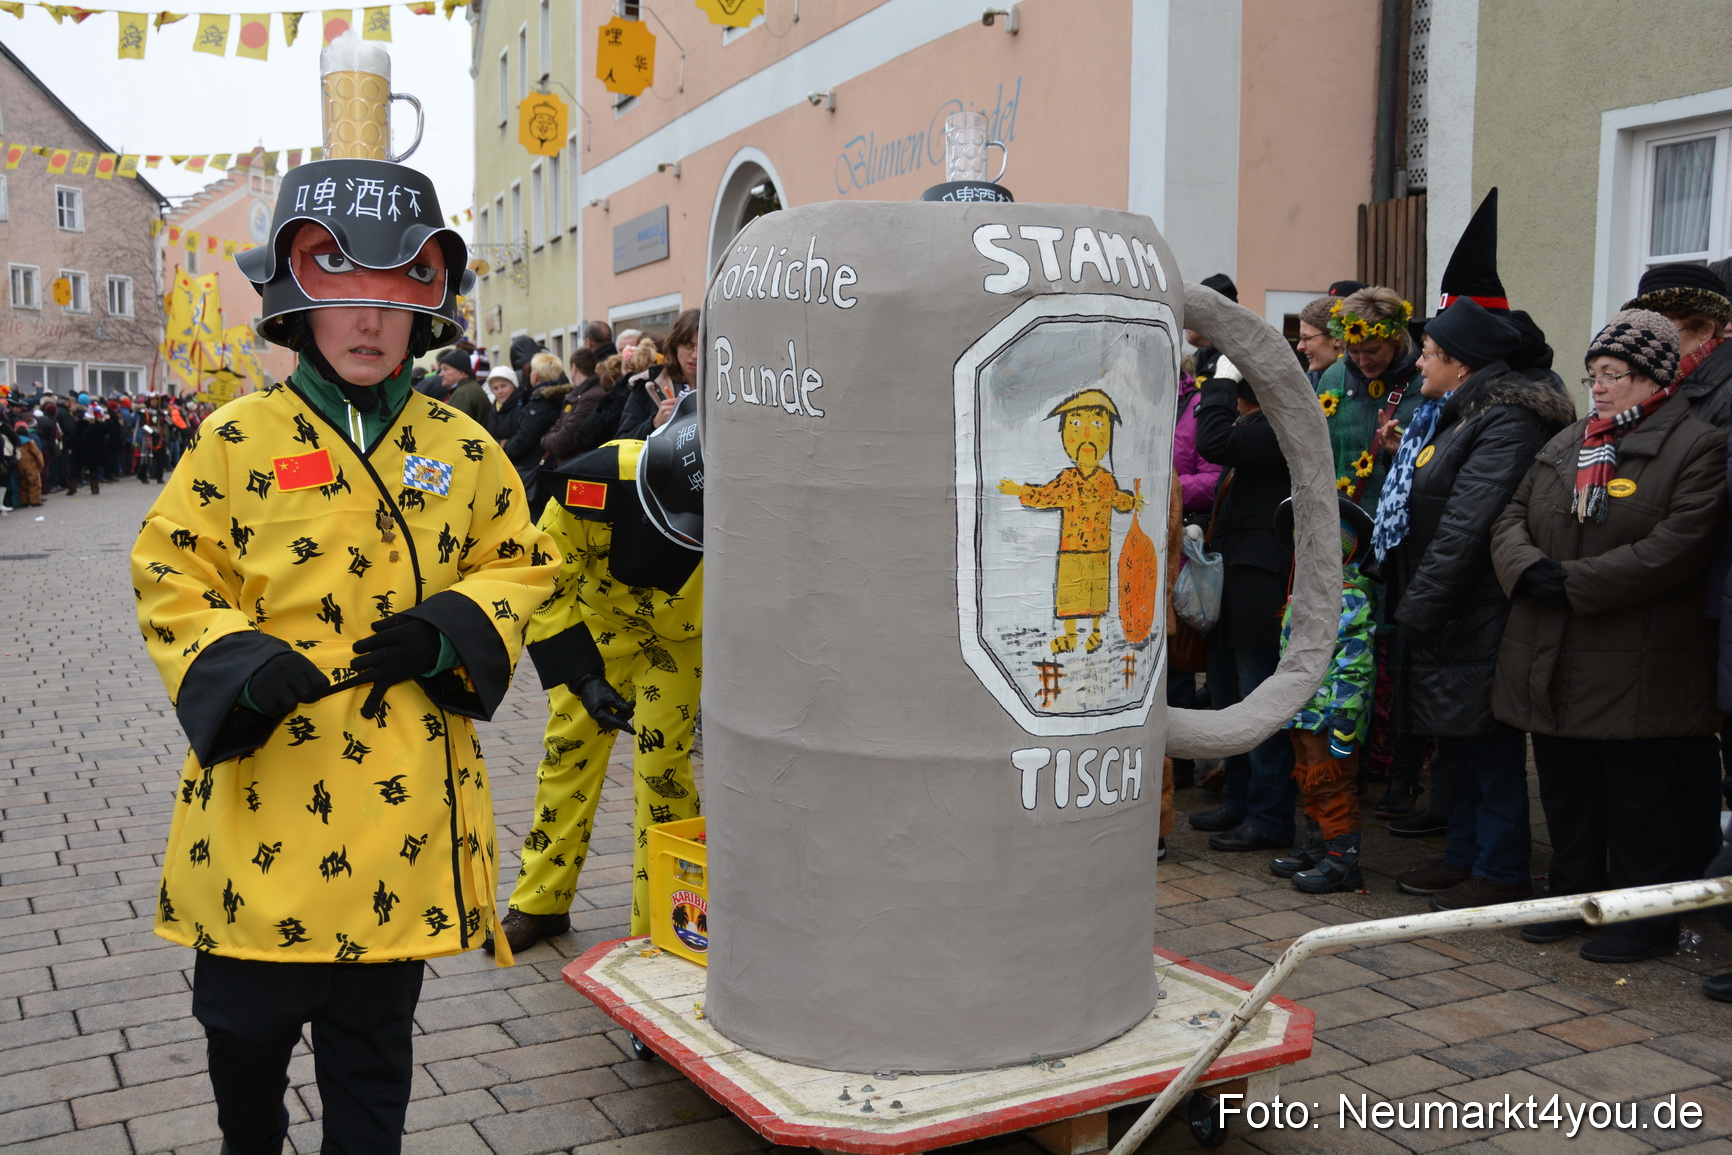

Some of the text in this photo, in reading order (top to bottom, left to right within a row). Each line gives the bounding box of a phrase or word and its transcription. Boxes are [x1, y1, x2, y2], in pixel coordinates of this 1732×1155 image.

[835, 130, 925, 195] Blumen
[294, 177, 422, 222] 啤酒杯
[972, 223, 1168, 295] STAMM
[714, 335, 826, 418] Runde
[1011, 746, 1143, 811] TISCH
